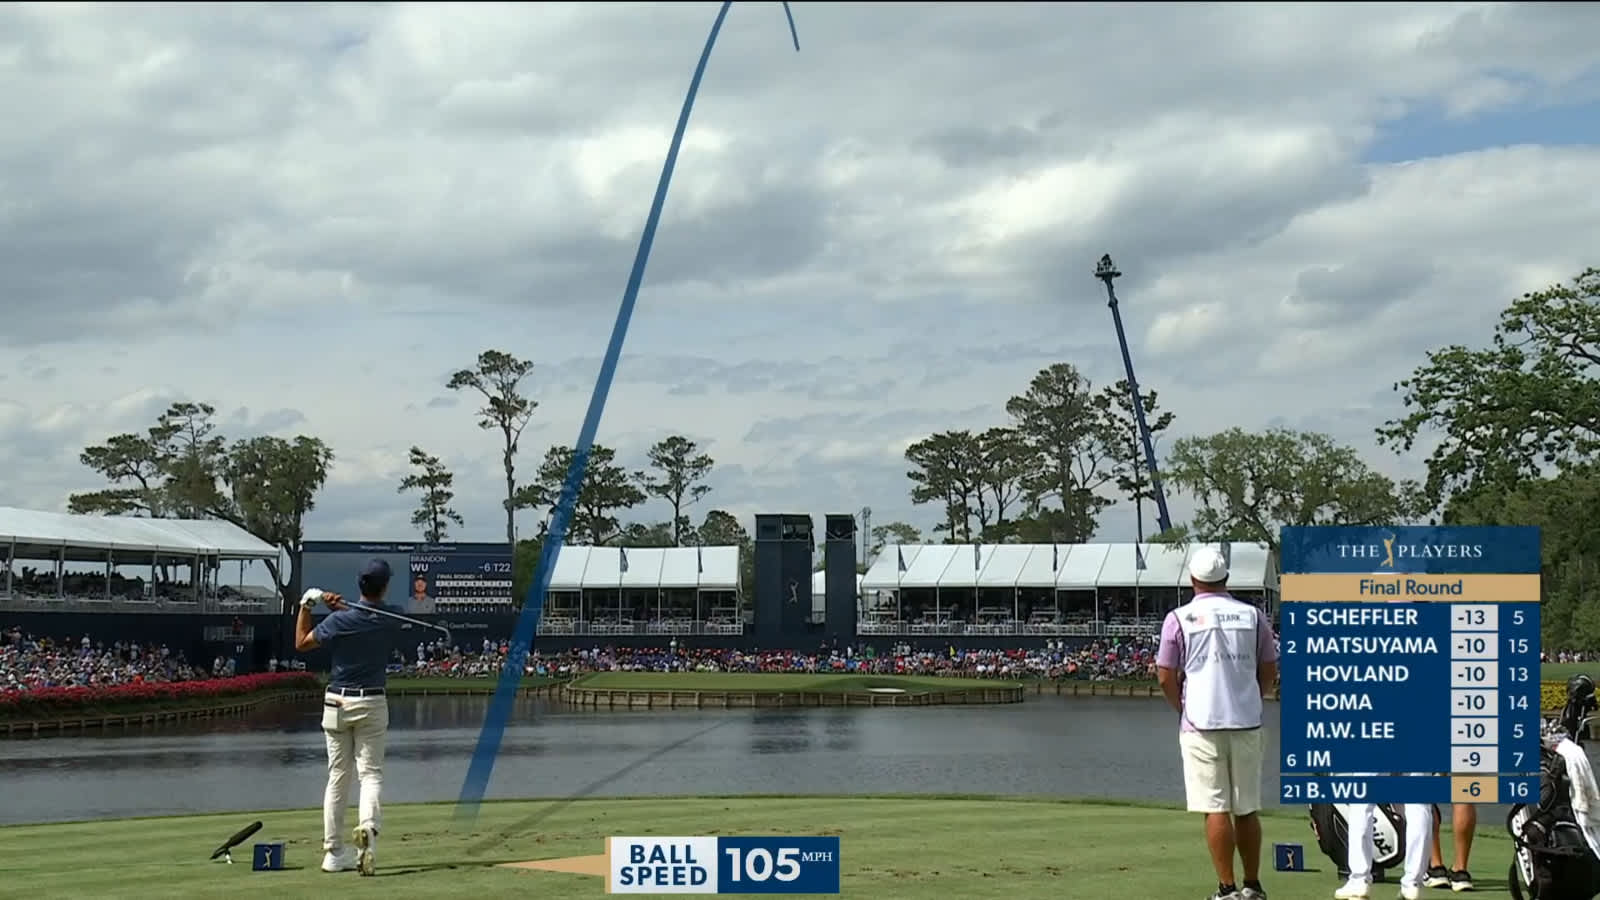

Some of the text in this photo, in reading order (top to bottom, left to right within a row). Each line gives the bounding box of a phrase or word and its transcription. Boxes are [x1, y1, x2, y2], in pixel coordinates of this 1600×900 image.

[410, 563, 511, 572] WU -6 T22
[236, 645, 244, 653] 17
